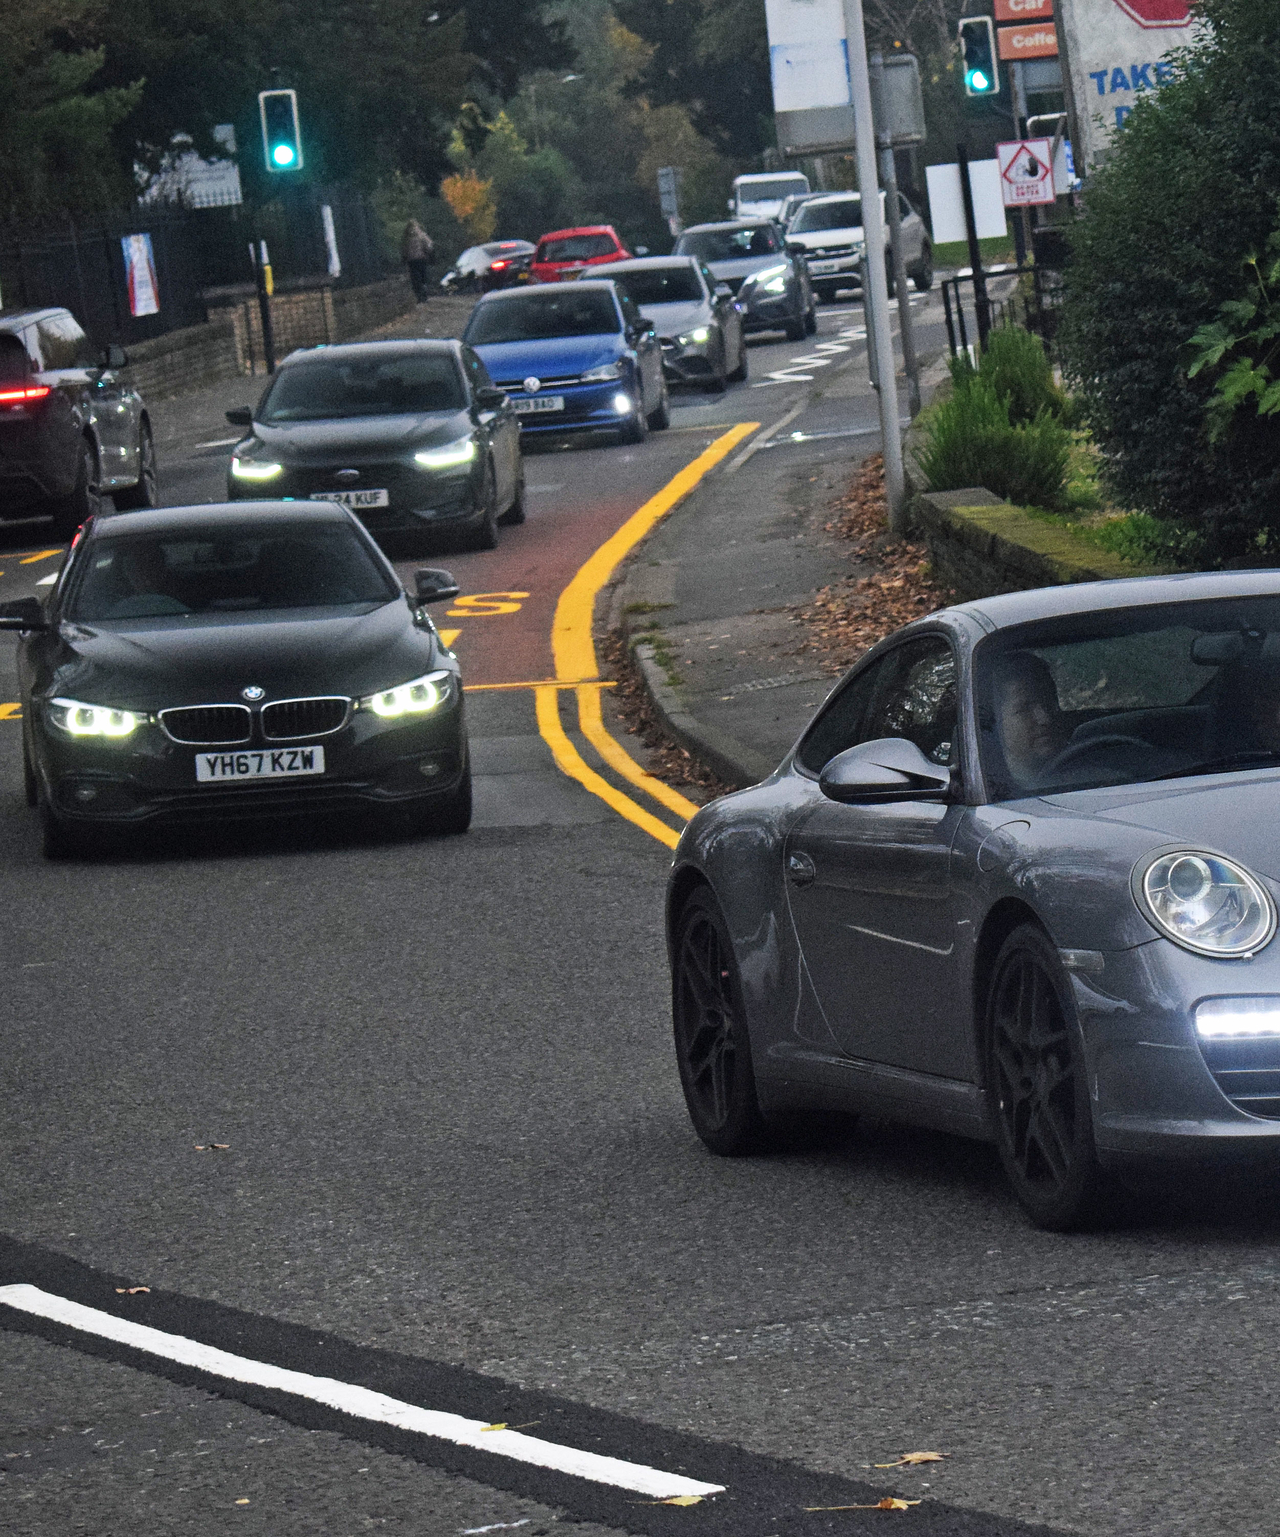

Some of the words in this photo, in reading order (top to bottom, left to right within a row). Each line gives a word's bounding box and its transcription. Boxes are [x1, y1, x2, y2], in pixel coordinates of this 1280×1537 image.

[1009, 0, 1044, 11] Car
[1089, 62, 1176, 96] TAKE
[355, 491, 382, 505] KUF
[205, 753, 264, 777] YH67
[270, 749, 314, 772] KZW
